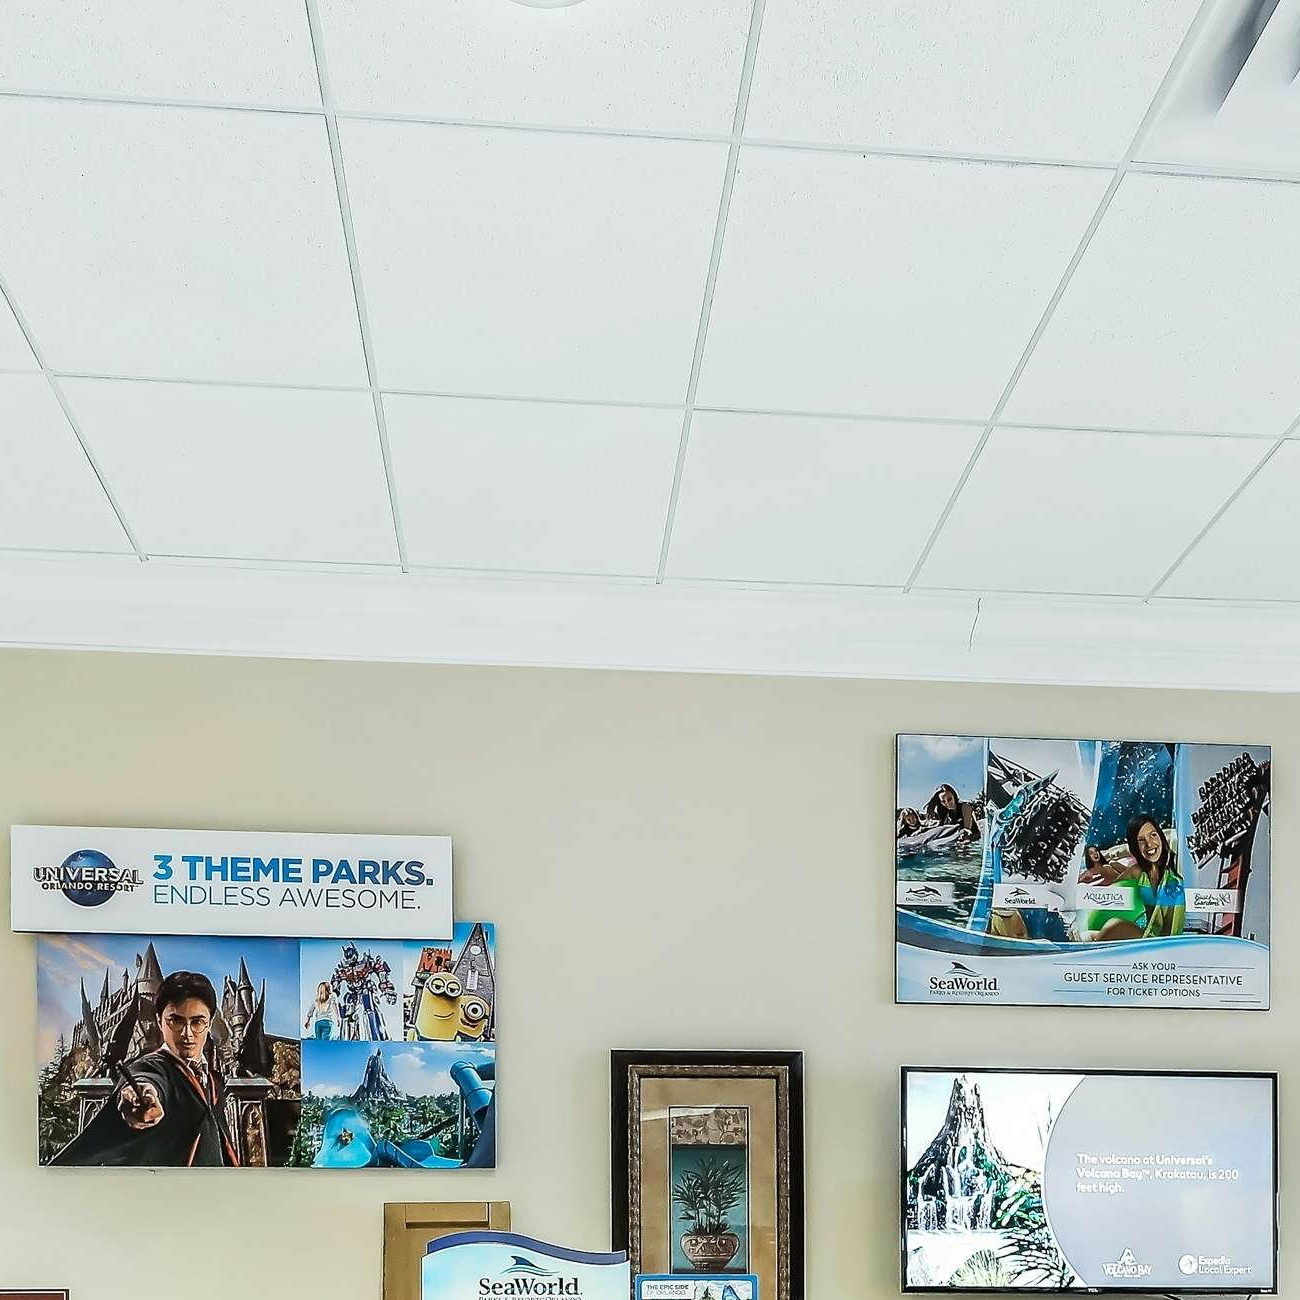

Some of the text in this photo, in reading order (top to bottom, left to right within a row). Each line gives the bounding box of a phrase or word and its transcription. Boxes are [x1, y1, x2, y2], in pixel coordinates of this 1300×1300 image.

[32, 865, 144, 886] UNIVERSAL
[153, 855, 434, 887] 3 THEME PARKS.
[153, 884, 422, 909] ENDLESS AWESOME.
[1083, 893, 1123, 901] AQUATICA
[1151, 963, 1176, 971] YOUR
[1064, 973, 1243, 985] GUEST SERVICE REPRESENTATIVE
[1107, 988, 1200, 997] FOR TICKET OPTIONS
[1077, 1154, 1212, 1166] The volcano at Universal's
[1076, 1168, 1120, 1178] Volcano
[1208, 1170, 1216, 1179] is
[1219, 1170, 1239, 1180] 200
[1076, 1182, 1124, 1194] feet high.
[1200, 1266, 1252, 1275] Local Expert
